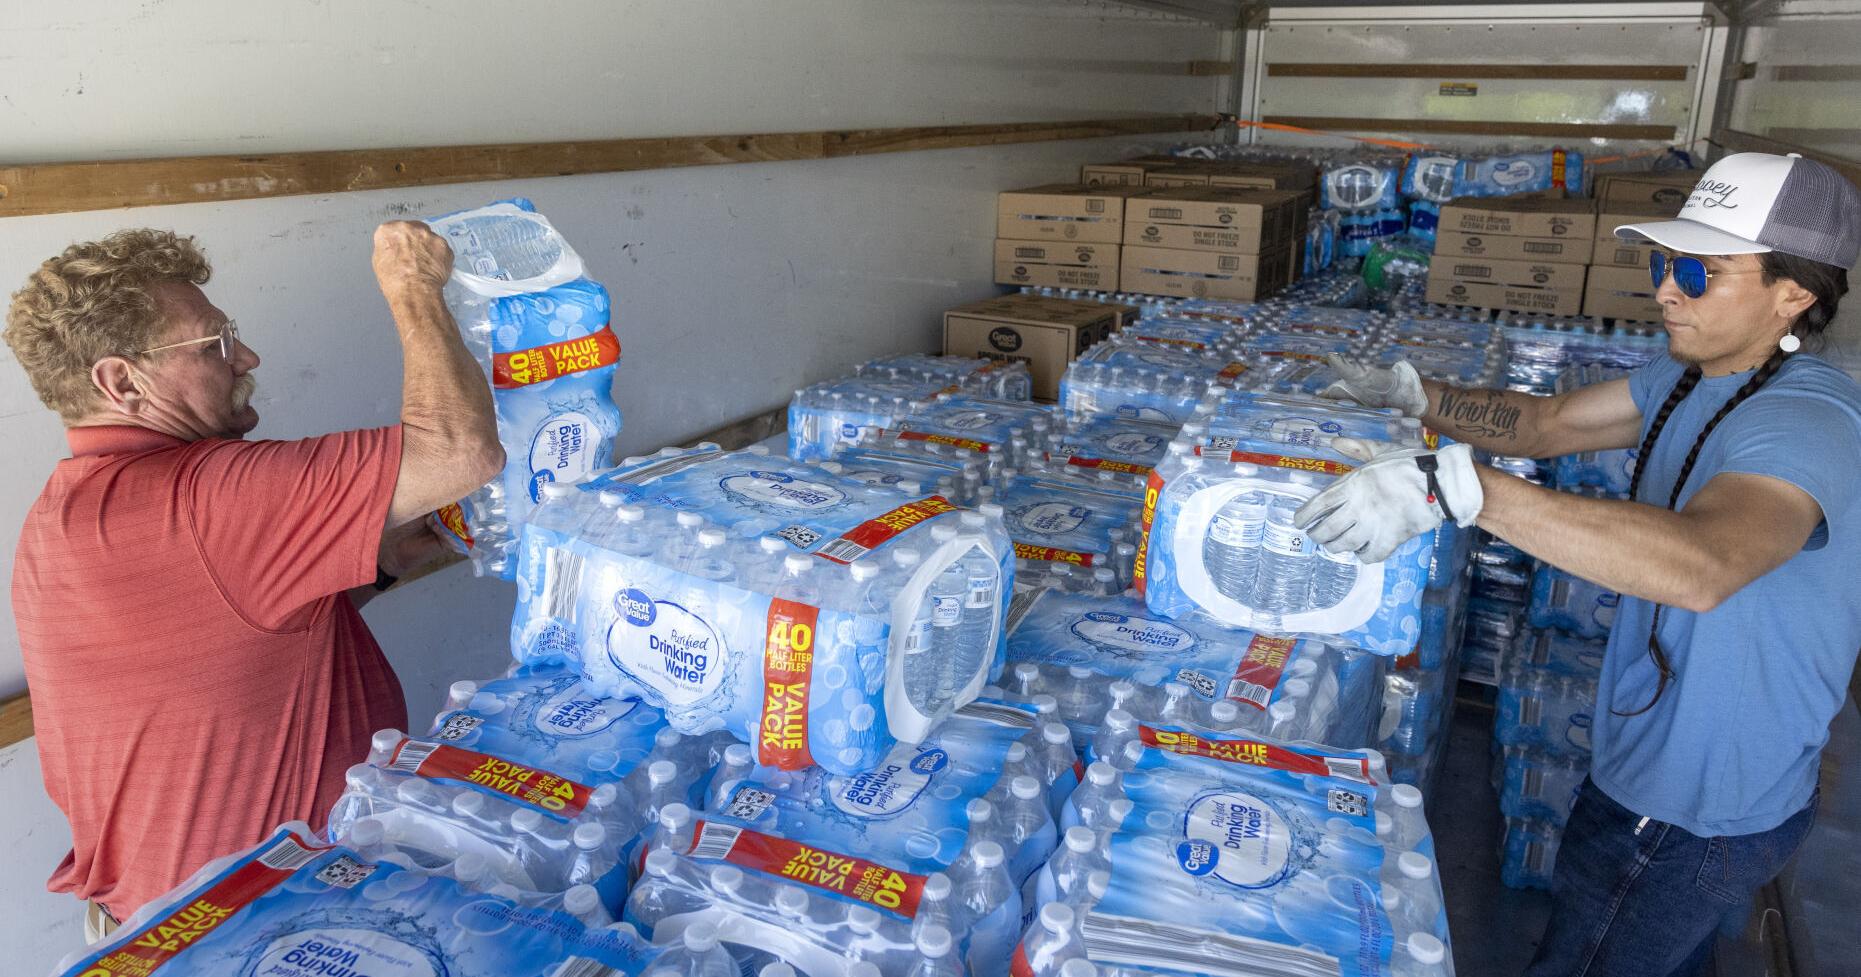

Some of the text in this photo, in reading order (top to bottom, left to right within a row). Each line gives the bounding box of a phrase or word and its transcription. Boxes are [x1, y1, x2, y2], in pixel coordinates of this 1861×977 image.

[549, 337, 600, 362] VALUE
[556, 353, 601, 375] PACK
[508, 353, 533, 384] 40
[557, 424, 572, 469] Drinking
[569, 423, 582, 456] Water
[874, 506, 916, 524] PACK
[618, 593, 651, 614] Great
[626, 606, 651, 622] Value
[670, 629, 710, 651] Purified
[769, 623, 812, 652] 40
[1116, 626, 1180, 643] Drinking
[649, 634, 707, 671] Drinking
[766, 649, 813, 664] HALF LITER
[769, 661, 807, 673] BOTTLES
[664, 655, 707, 685] Water
[762, 682, 785, 749] PACK
[783, 681, 806, 750] VALUE
[465, 769, 522, 795] VALUE
[478, 757, 536, 783] PACK
[856, 764, 902, 806] Drinking
[540, 781, 575, 811] 40
[1223, 803, 1249, 850] Drinking
[793, 847, 857, 876] PACK
[1184, 843, 1202, 871] Great
[782, 860, 846, 890] VALUE
[873, 871, 908, 908] 40
[134, 899, 218, 949] VALUE
[159, 905, 235, 952] PACK
[298, 938, 361, 968] Water
